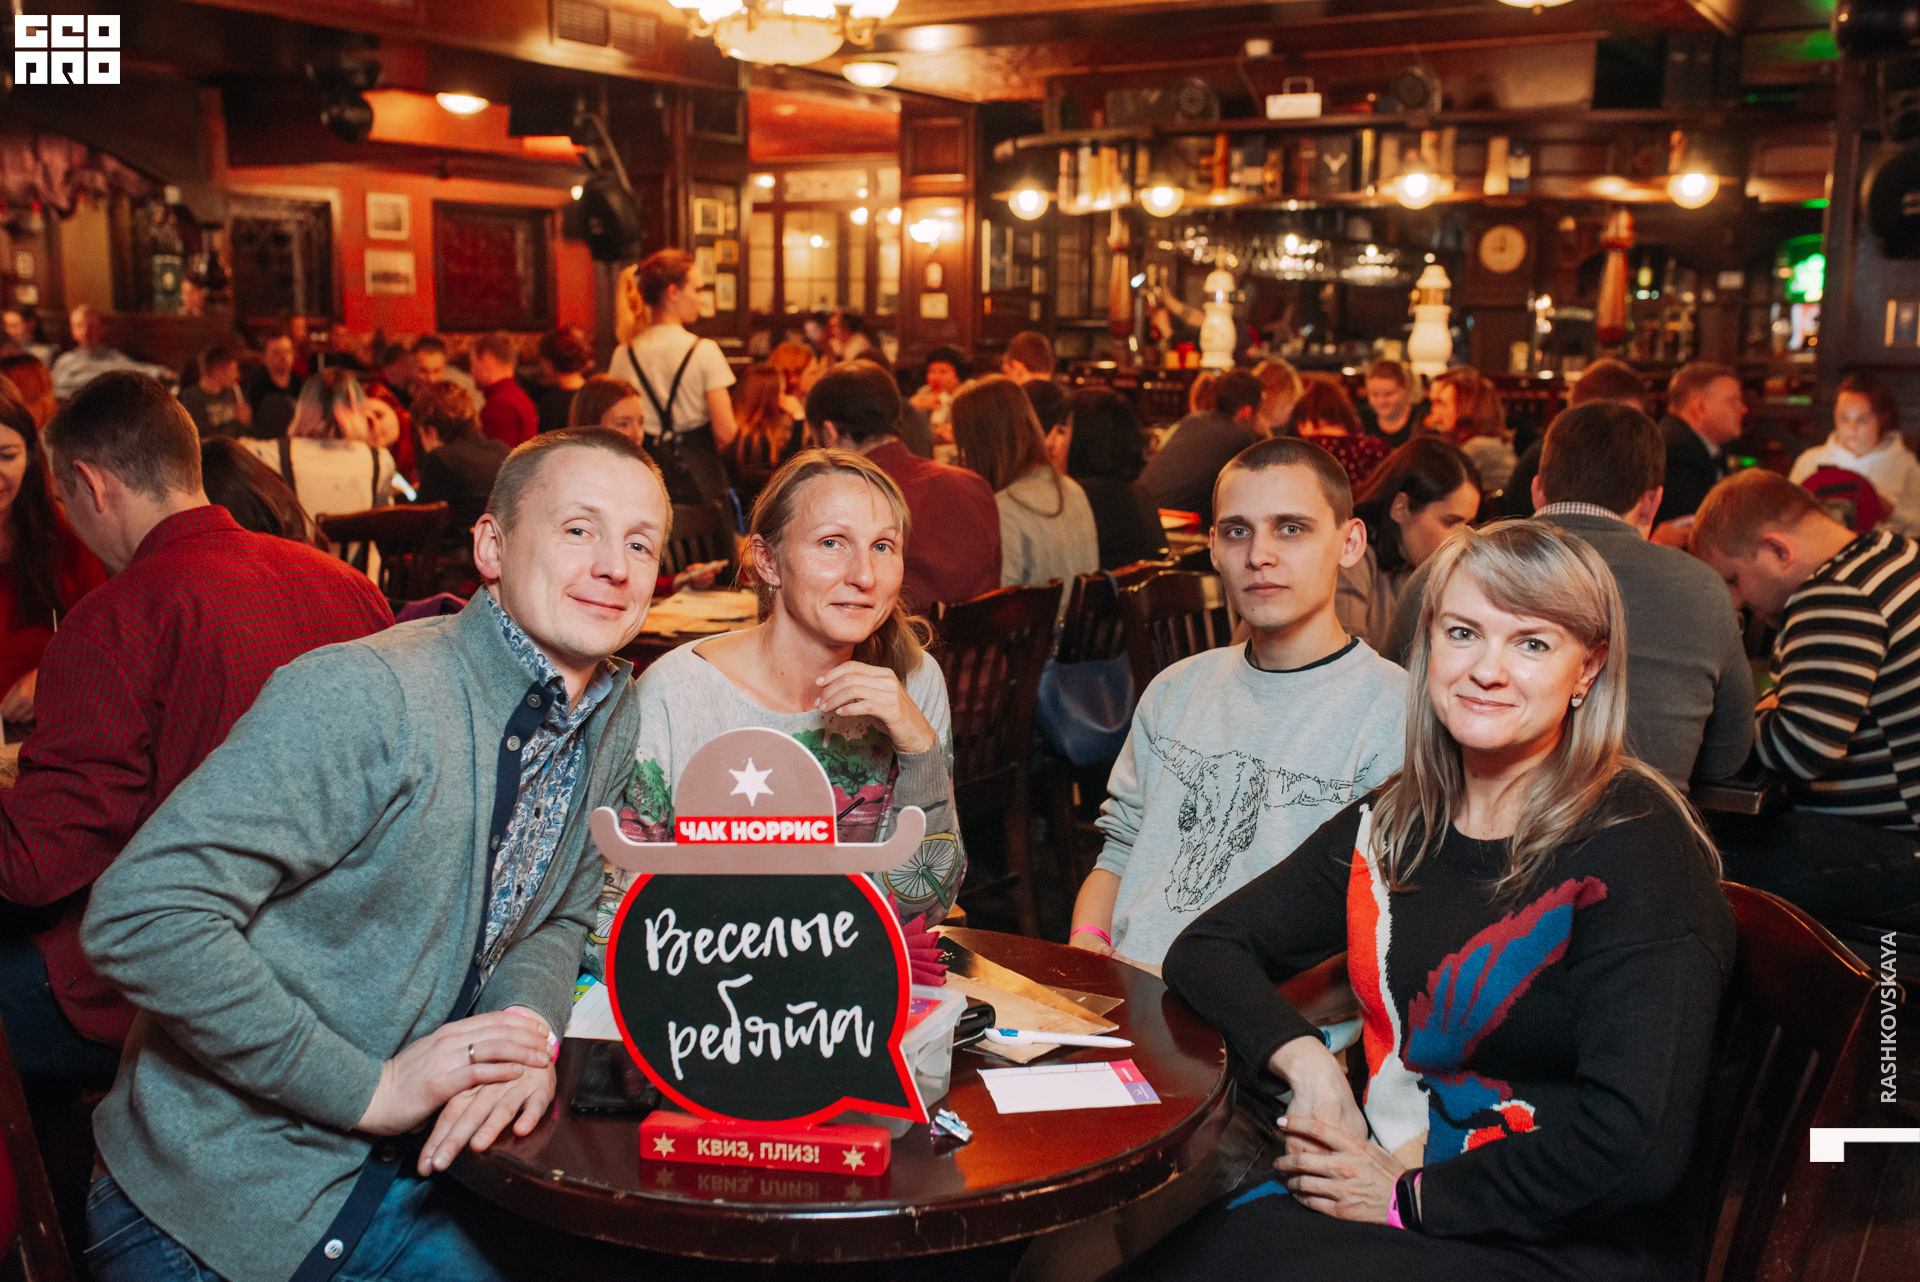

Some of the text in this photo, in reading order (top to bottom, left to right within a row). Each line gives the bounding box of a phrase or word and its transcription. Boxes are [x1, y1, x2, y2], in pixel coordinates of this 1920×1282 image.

[679, 820, 829, 841] ЧАК НОРРИС
[645, 908, 858, 976] Веселые
[668, 974, 874, 1080] ребята
[697, 1138, 820, 1164] КВИЗ, ПЛИЗ!
